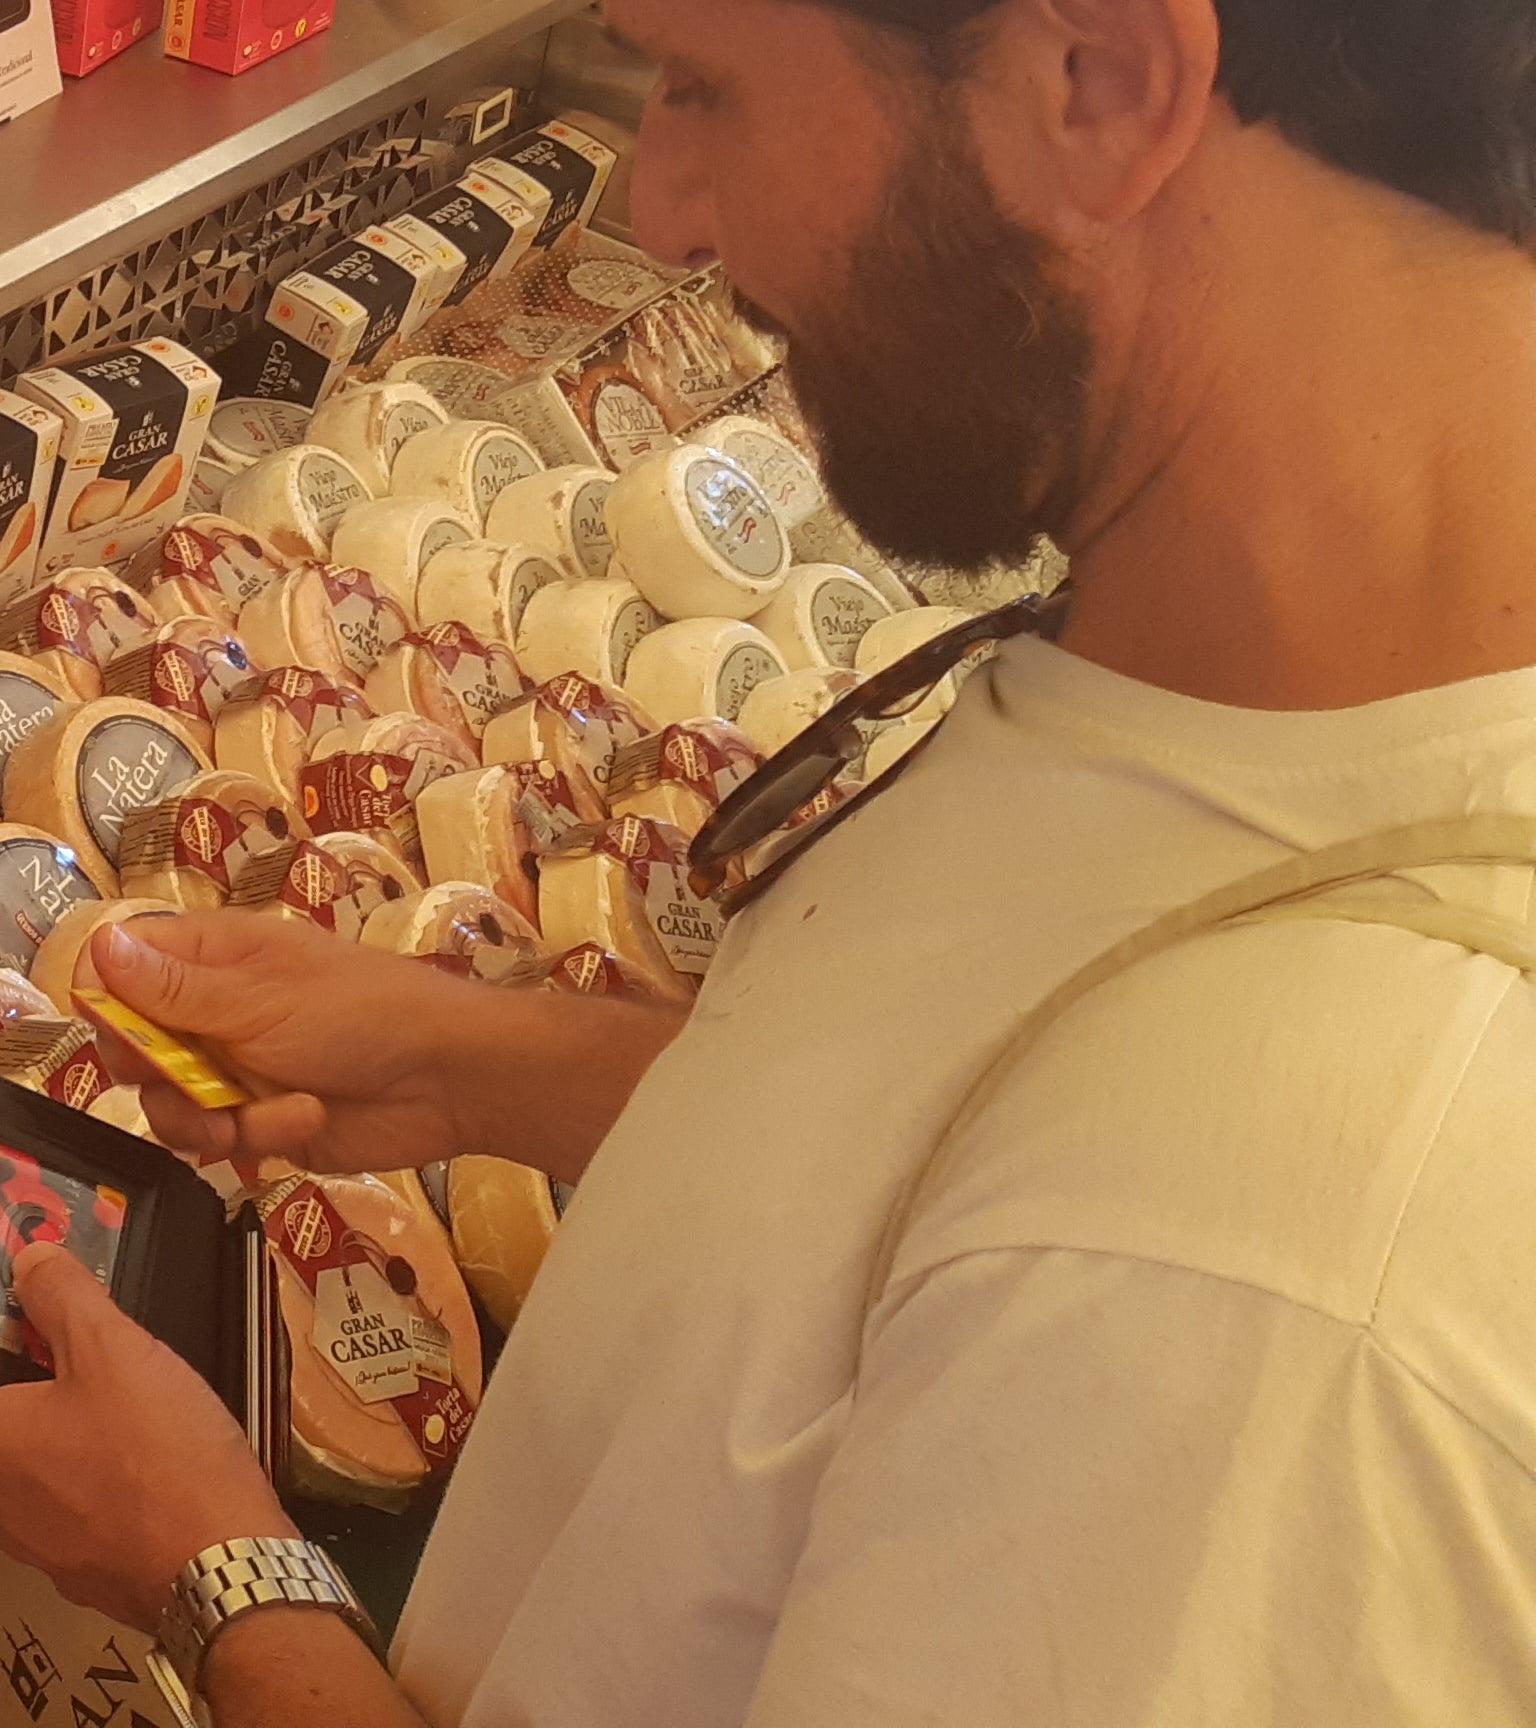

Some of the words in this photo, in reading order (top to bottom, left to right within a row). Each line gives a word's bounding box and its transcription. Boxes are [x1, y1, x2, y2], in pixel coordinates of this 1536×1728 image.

[428, 196, 473, 226] CASAR
[329, 249, 373, 280] CASAR
[83, 353, 143, 379] CASAR
[253, 339, 288, 398] CASAR
[111, 430, 169, 461] CASAR
[128, 423, 164, 442] GRAN
[89, 751, 132, 796] La
[667, 902, 702, 918] GRAN
[656, 915, 716, 943] CASAR
[339, 1313, 385, 1337] GRAN
[330, 1328, 412, 1364] CASAR
[435, 1386, 462, 1415] Torta
